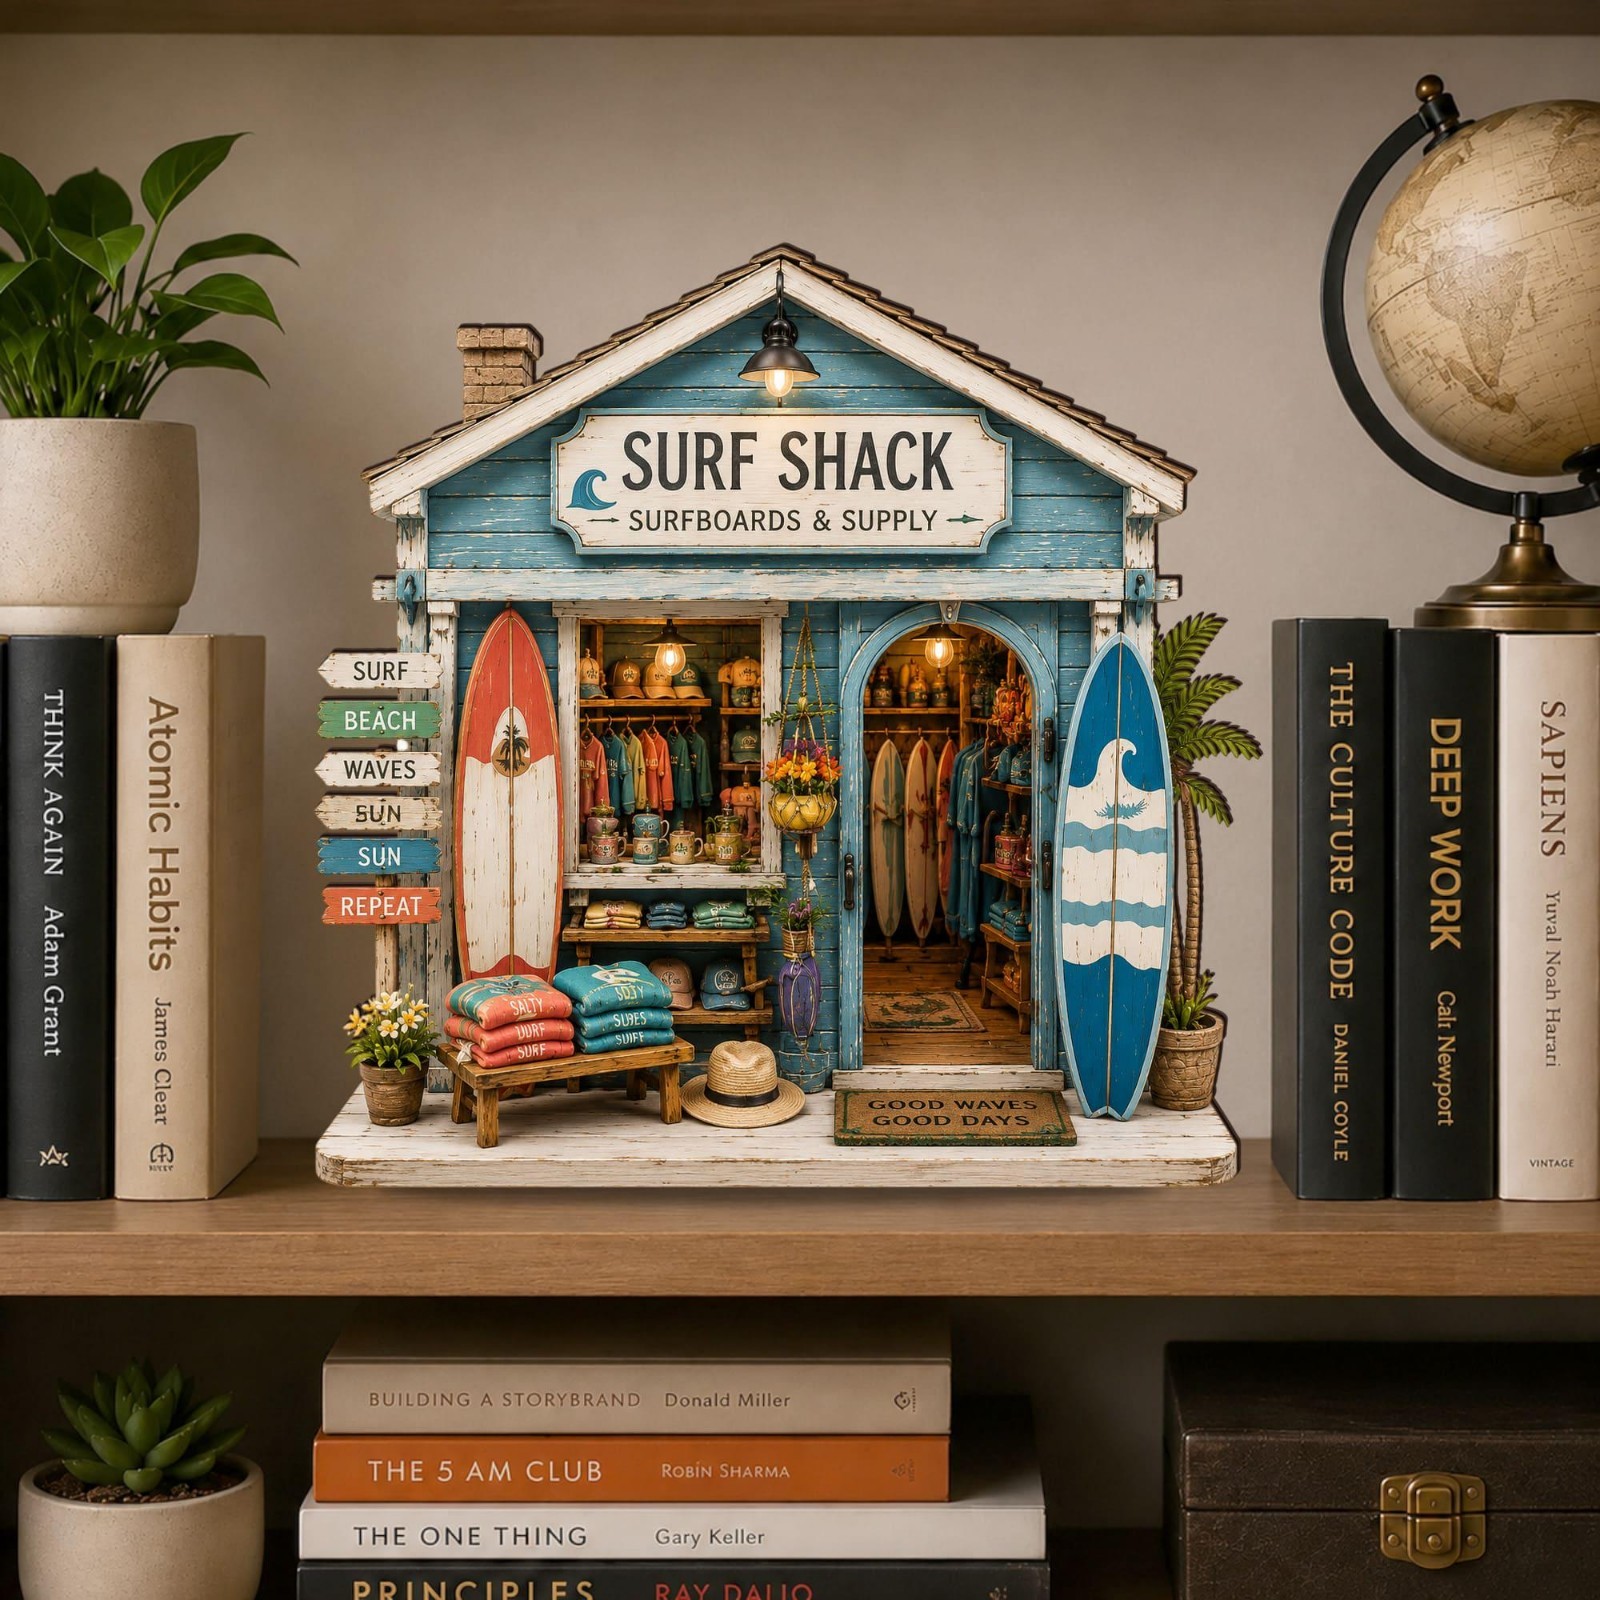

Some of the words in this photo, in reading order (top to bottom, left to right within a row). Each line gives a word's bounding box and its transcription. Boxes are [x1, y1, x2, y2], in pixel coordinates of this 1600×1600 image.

[621, 430, 758, 492] SURF
[778, 430, 954, 492] SHACK
[628, 509, 801, 532] SURFBOARDS
[812, 509, 832, 532] &
[841, 509, 938, 532] SUPPLY
[353, 660, 409, 681] SURF
[1329, 661, 1354, 728] THE
[43, 689, 64, 778] THINK
[344, 707, 416, 731] BEACH
[148, 696, 181, 833] Atomic
[343, 756, 416, 780] WAVES
[1429, 718, 1462, 818] DEEP
[1540, 701, 1567, 857] SAPIENS
[42, 787, 64, 875] AGAIN
[355, 804, 401, 823] SUN
[1329, 742, 1354, 893] CULTURE
[358, 846, 401, 867] SUN
[148, 847, 181, 972] Habits
[341, 896, 423, 916] REPEAT
[1429, 828, 1462, 951] WORK
[43, 905, 65, 978] Adam
[1545, 890, 1563, 942] Yuval
[1329, 909, 1354, 999] CODE
[1545, 950, 1562, 1001] Noah
[43, 985, 65, 1057] Grant
[154, 997, 172, 1062] James
[509, 997, 543, 1016] SALTY
[516, 1043, 546, 1060] SURF
[1333, 1023, 1349, 1094] DANIEL
[1545, 1007, 1561, 1067] Harari
[154, 1068, 172, 1126] Clear
[868, 1099, 944, 1110] GOOD
[953, 1099, 1038, 1110] WAVES
[1432, 1035, 1456, 1127] Newport
[872, 1114, 951, 1126] GOOD
[961, 1114, 1030, 1126] DAYS
[1333, 1100, 1349, 1161] COYLE
[1529, 1158, 1575, 1168] VINTAGE
[369, 1392, 470, 1407] BUILDING
[480, 1392, 493, 1407] A
[502, 1392, 641, 1408] STORYBRAND
[665, 1392, 730, 1408] Donald
[738, 1392, 791, 1408] Miller
[367, 1460, 423, 1482] THE
[437, 1460, 453, 1482] 5
[465, 1461, 512, 1482] AM
[526, 1460, 602, 1482] CLUB
[353, 1526, 406, 1546] THE
[420, 1526, 481, 1546] ONE
[493, 1526, 587, 1546] THING
[655, 1528, 702, 1550] Gary
[709, 1528, 765, 1545] Keller
[655, 1583, 710, 1600] RAY
